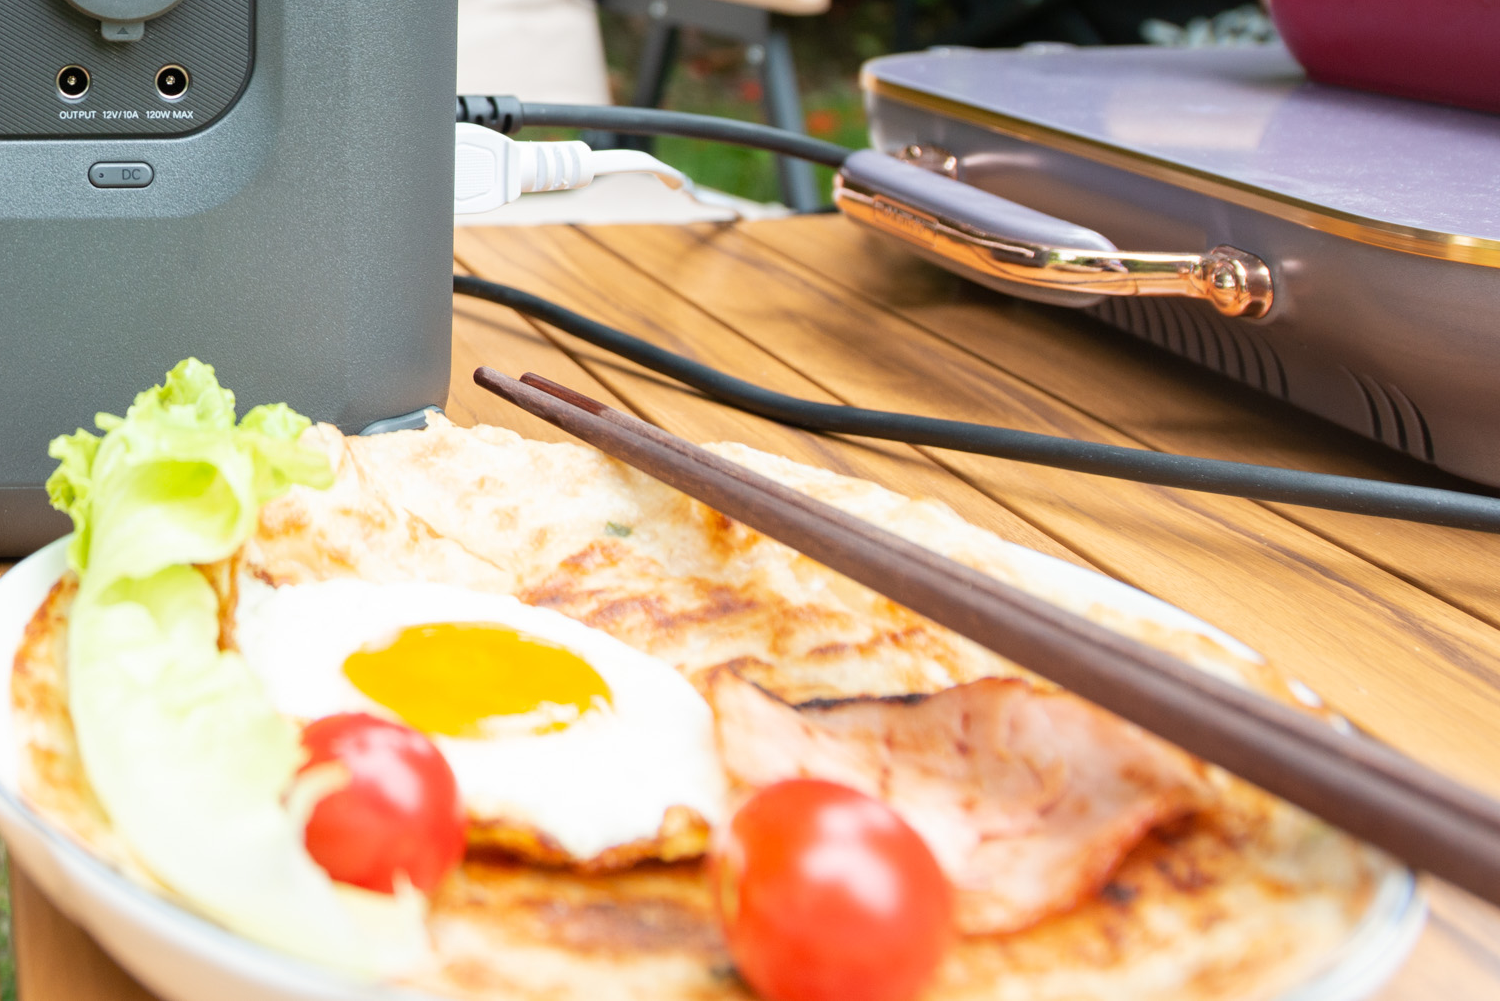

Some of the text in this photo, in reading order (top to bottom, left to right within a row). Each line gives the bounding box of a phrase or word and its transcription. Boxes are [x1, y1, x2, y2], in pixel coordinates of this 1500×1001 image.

[59, 110, 194, 120] OUTPUT 12V/10A 120W MAX
[121, 168, 141, 181] DC
